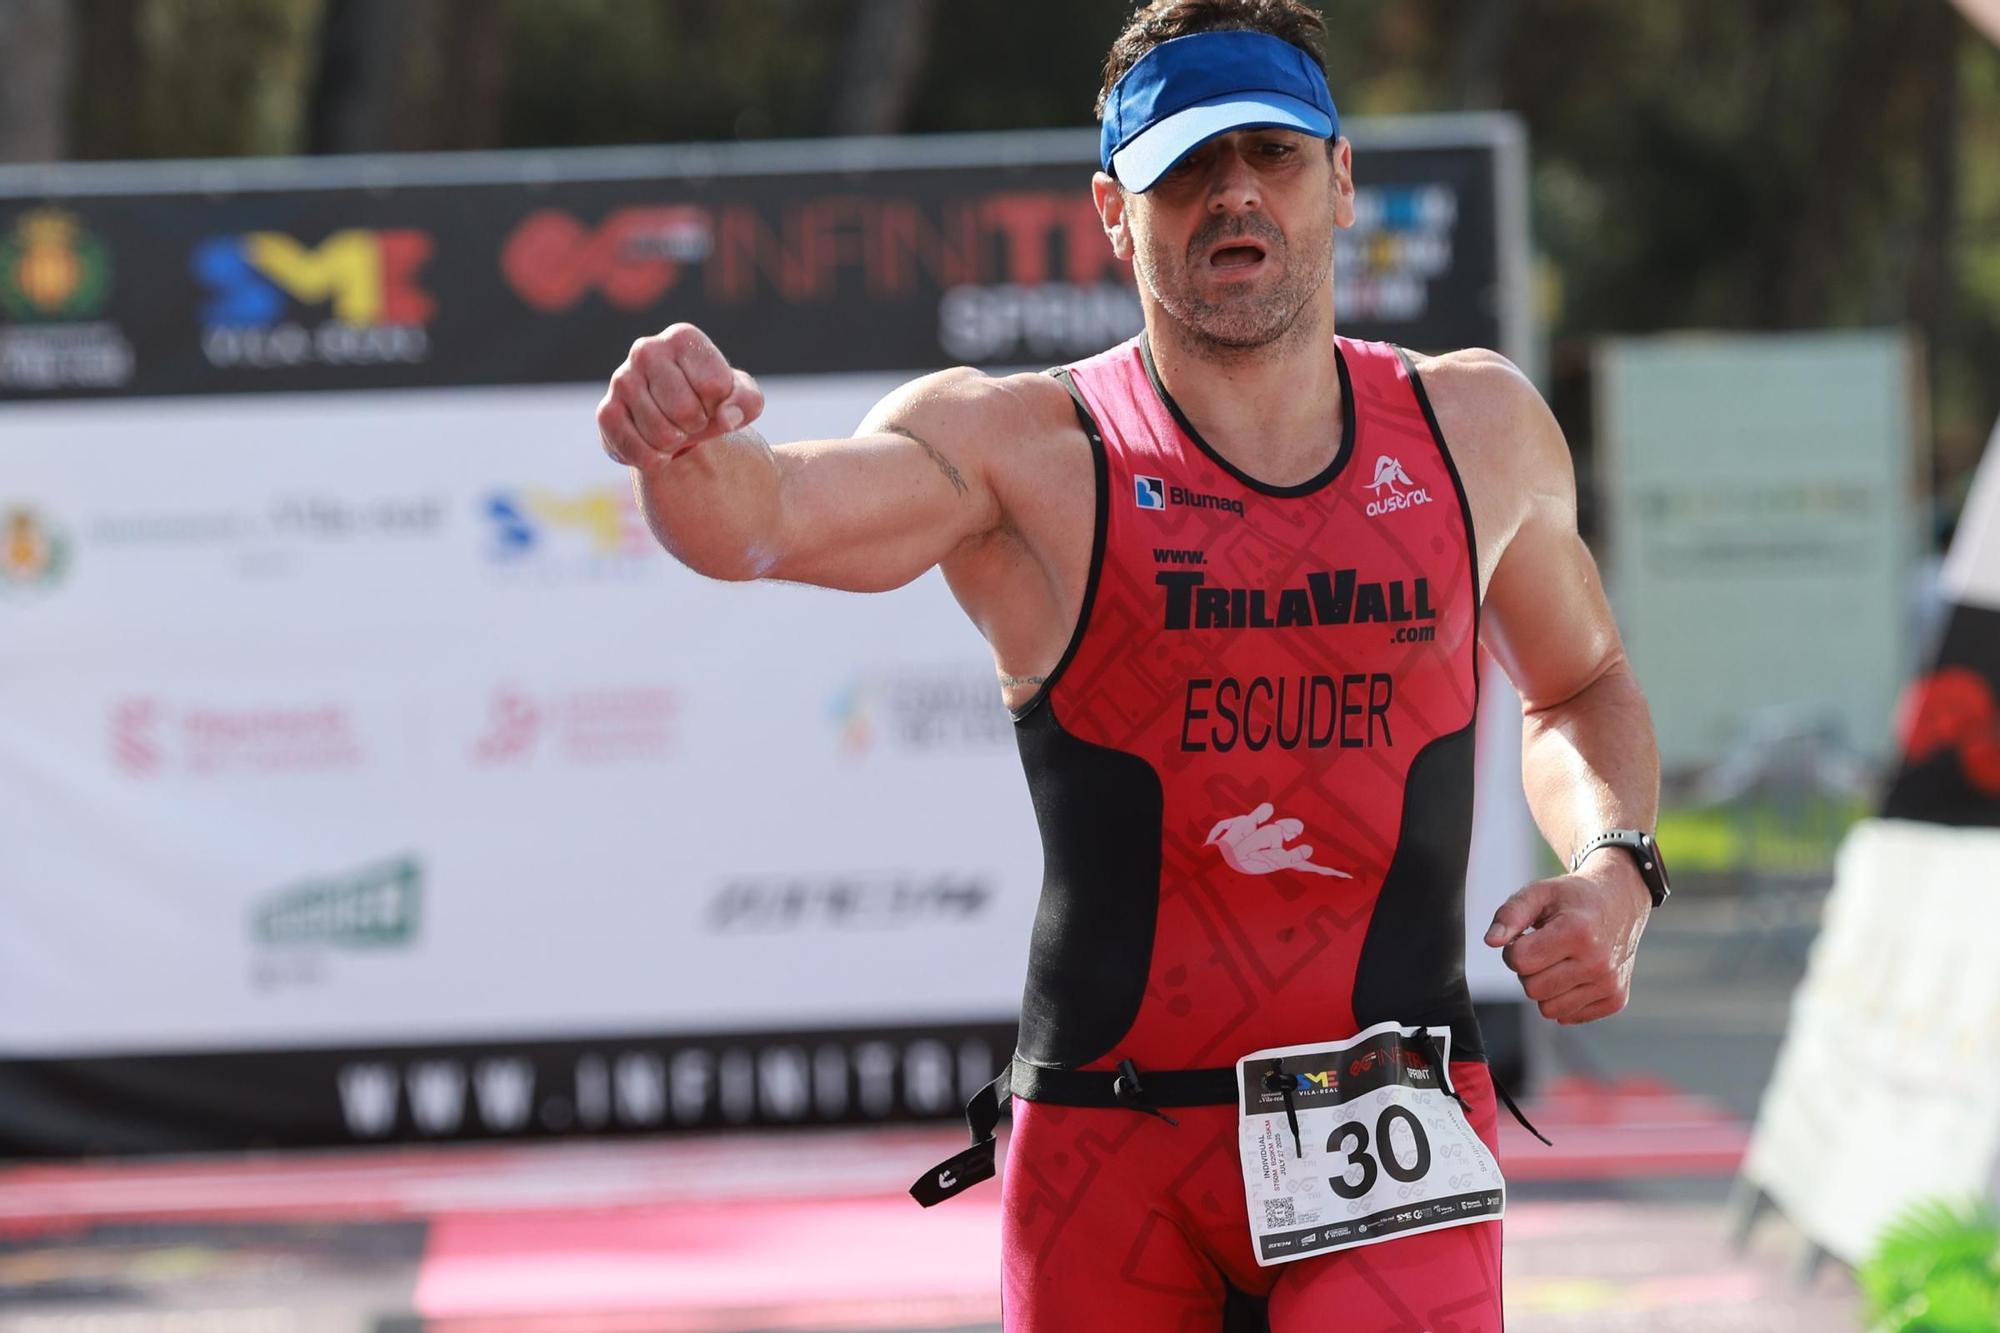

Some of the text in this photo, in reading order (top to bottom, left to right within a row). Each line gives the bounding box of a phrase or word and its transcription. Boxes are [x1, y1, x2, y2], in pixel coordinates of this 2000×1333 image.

[1169, 486, 1245, 518] Blumaq
[1365, 488, 1433, 517] austral
[1152, 547, 1208, 565] www.
[1390, 626, 1436, 644] .com
[1180, 672, 1394, 753] ESCUDER
[1296, 1070, 1339, 1090] SME
[1406, 1066, 1430, 1080] SPRINT
[1299, 1086, 1339, 1097] VILA-REAL
[1258, 1134, 1271, 1179] INDIVIDUAL
[1326, 1104, 1432, 1200] 30
[1279, 1159, 1287, 1176] JULY
